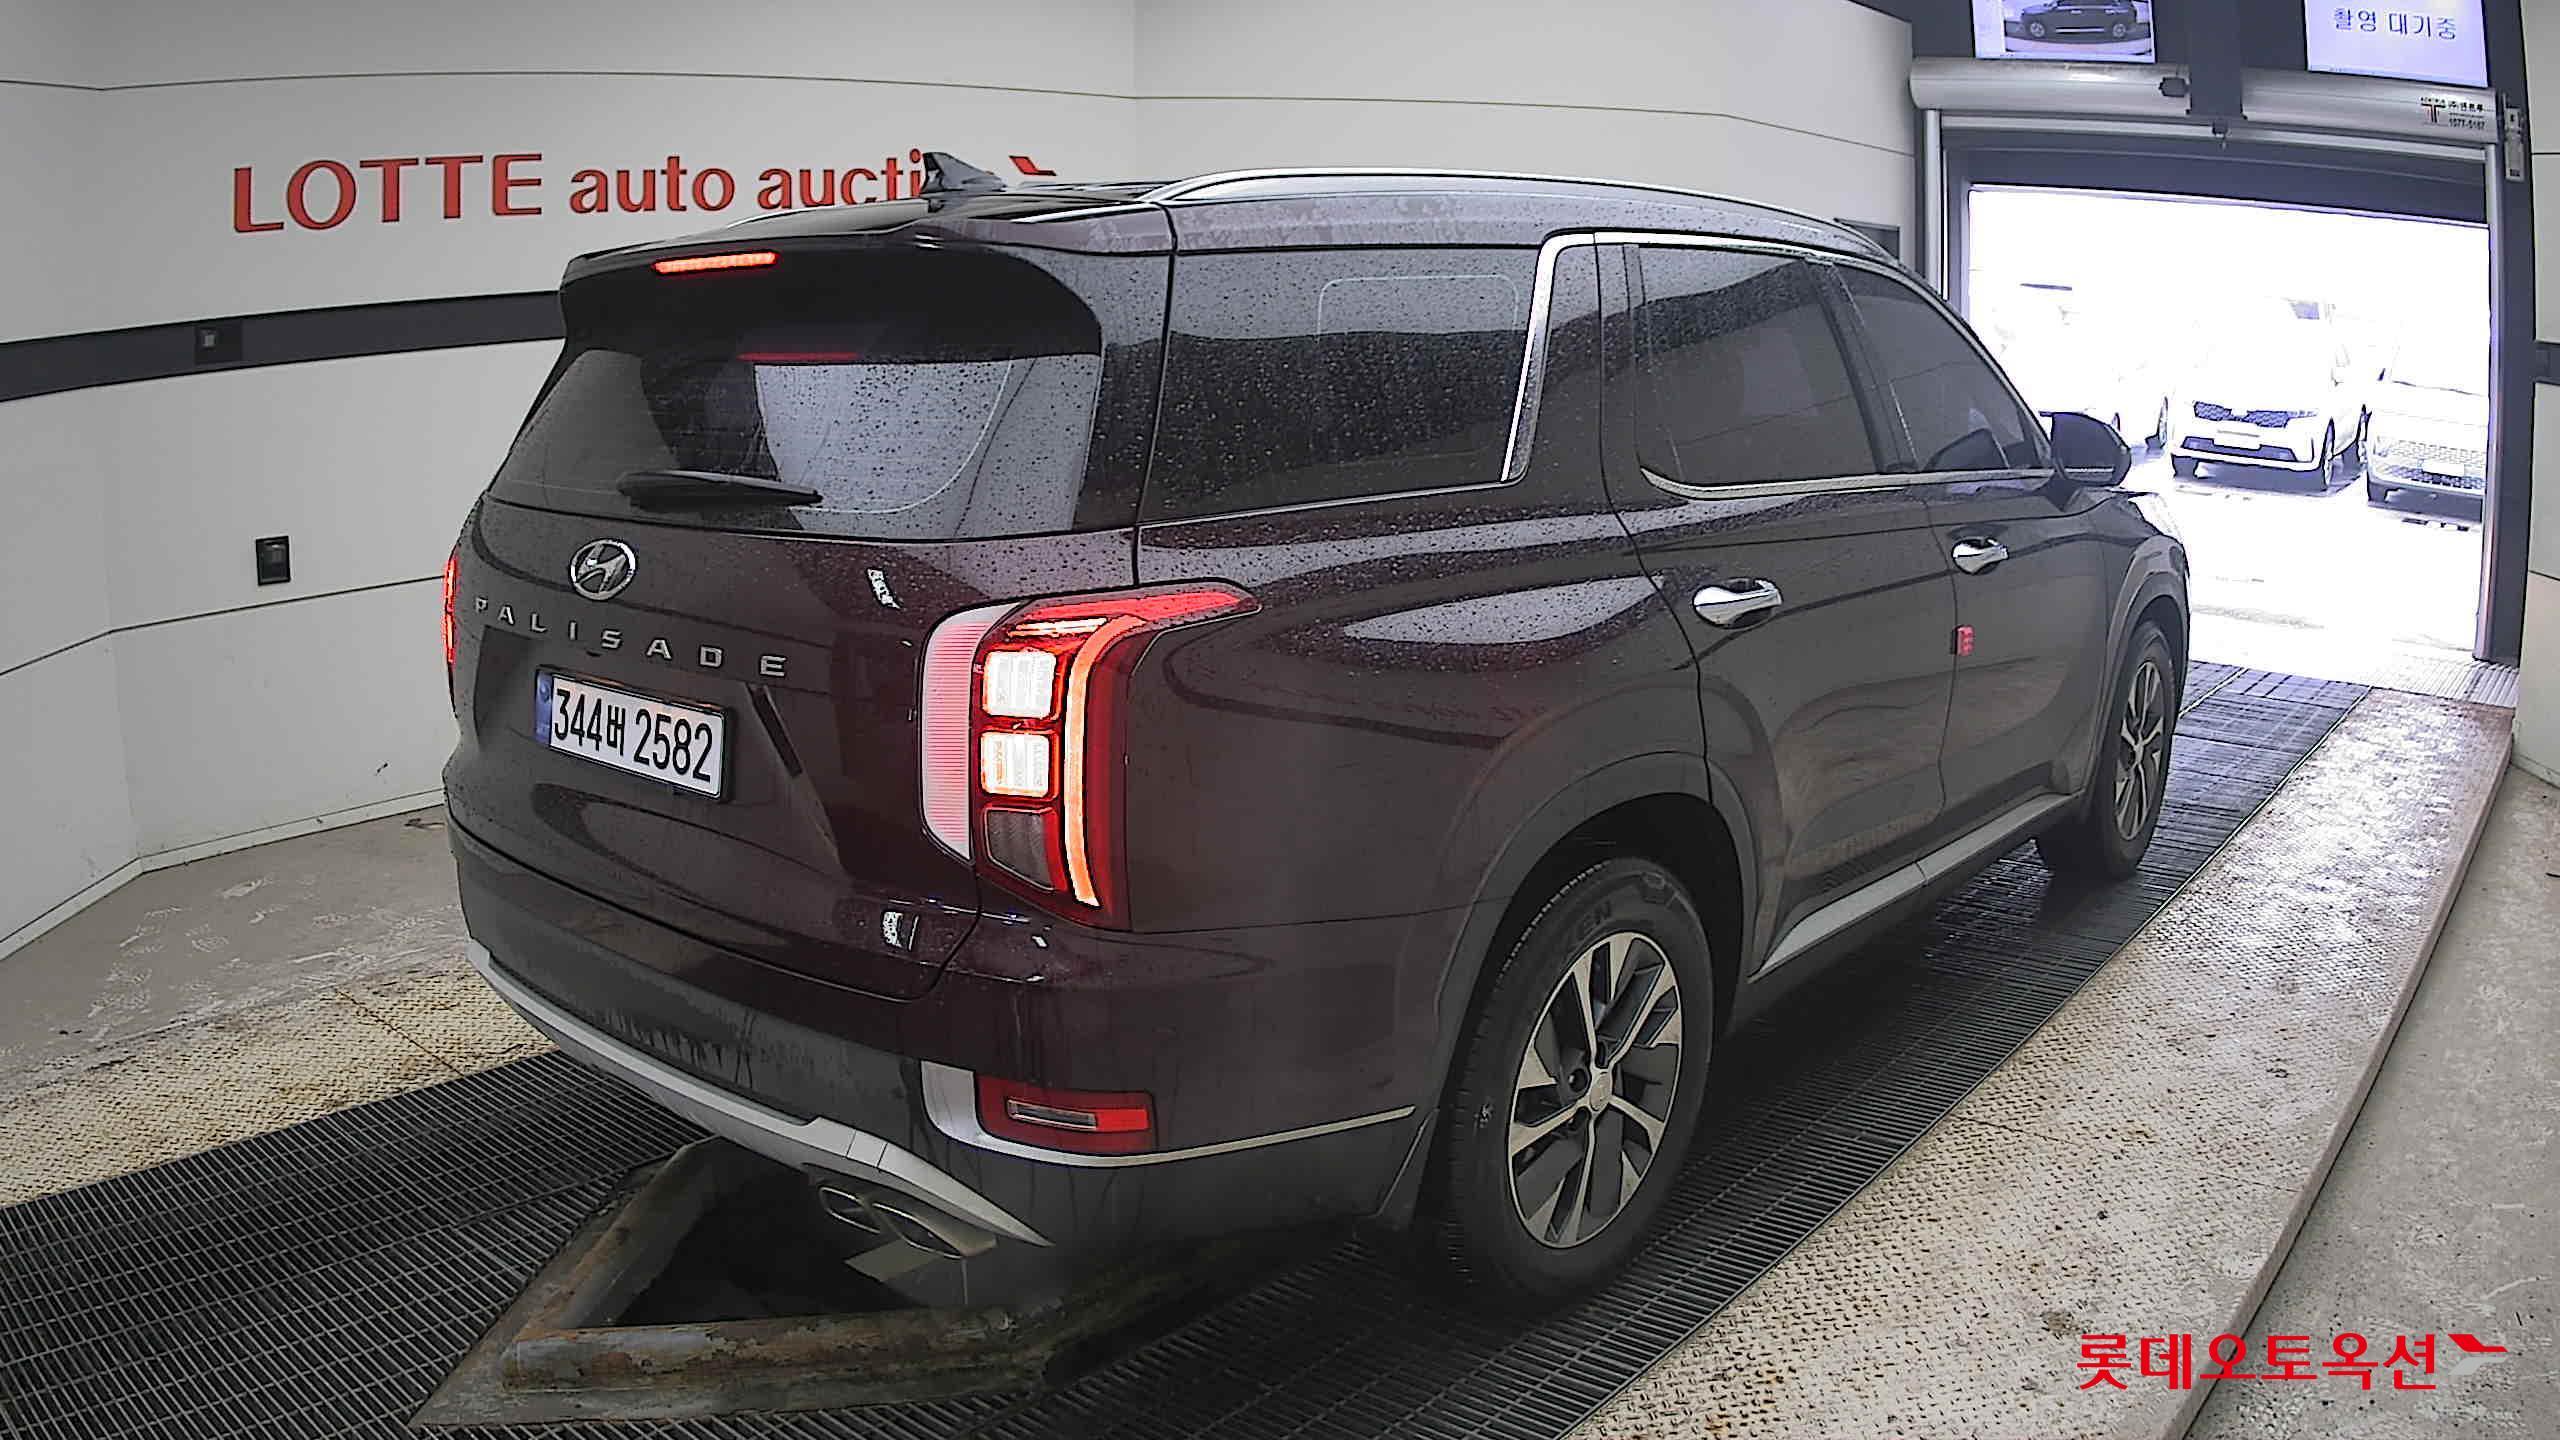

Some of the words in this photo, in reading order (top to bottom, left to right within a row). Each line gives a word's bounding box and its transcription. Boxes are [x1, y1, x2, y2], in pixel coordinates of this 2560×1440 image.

[2334, 8, 2377, 32] 촬영
[2388, 13, 2457, 40] 대기중
[233, 153, 543, 233] LOTTE
[569, 155, 736, 214] auto
[756, 148, 926, 210] aucti
[474, 596, 787, 678] PALISADE
[553, 688, 627, 757] 344버
[633, 708, 711, 783] 2582
